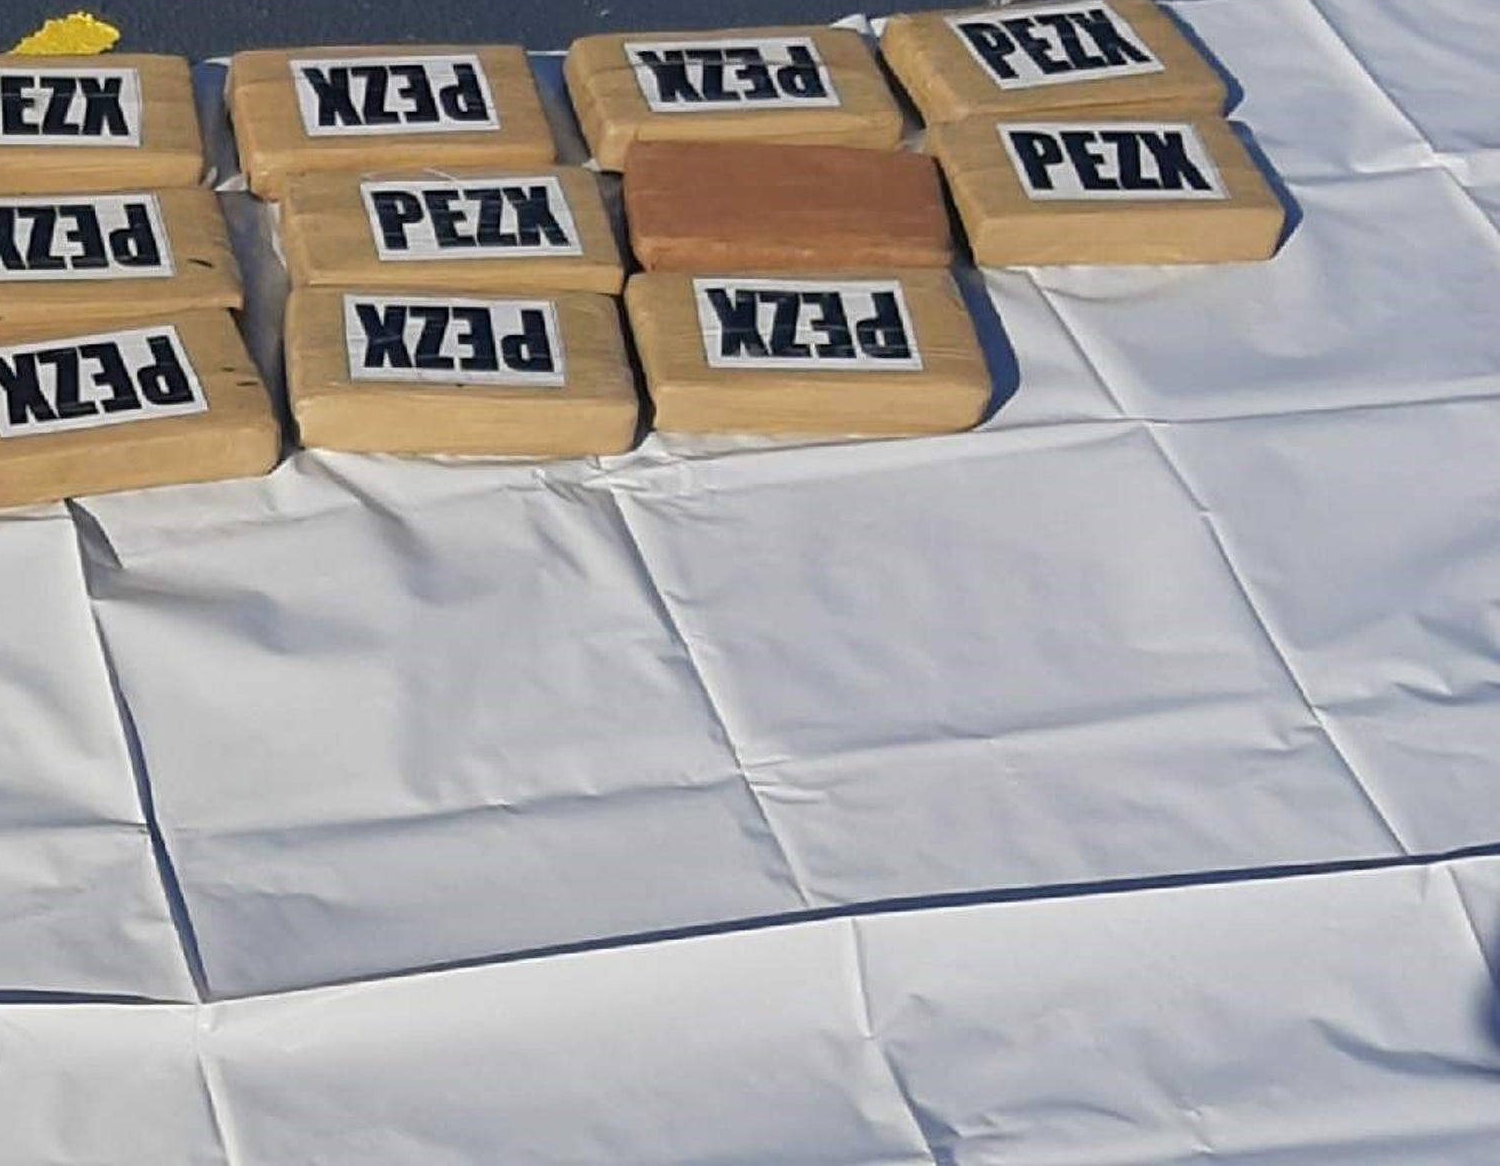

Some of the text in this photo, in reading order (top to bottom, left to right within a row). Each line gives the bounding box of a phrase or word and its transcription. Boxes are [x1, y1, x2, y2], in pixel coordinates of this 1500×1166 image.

[637, 46, 827, 103] PEZX
[958, 9, 1151, 79] PEZX
[302, 63, 489, 126] PEZX
[1009, 131, 1212, 190] PEZX
[371, 186, 569, 249] PEZX
[356, 304, 554, 372] PEZX
[705, 288, 911, 358] PEZX
